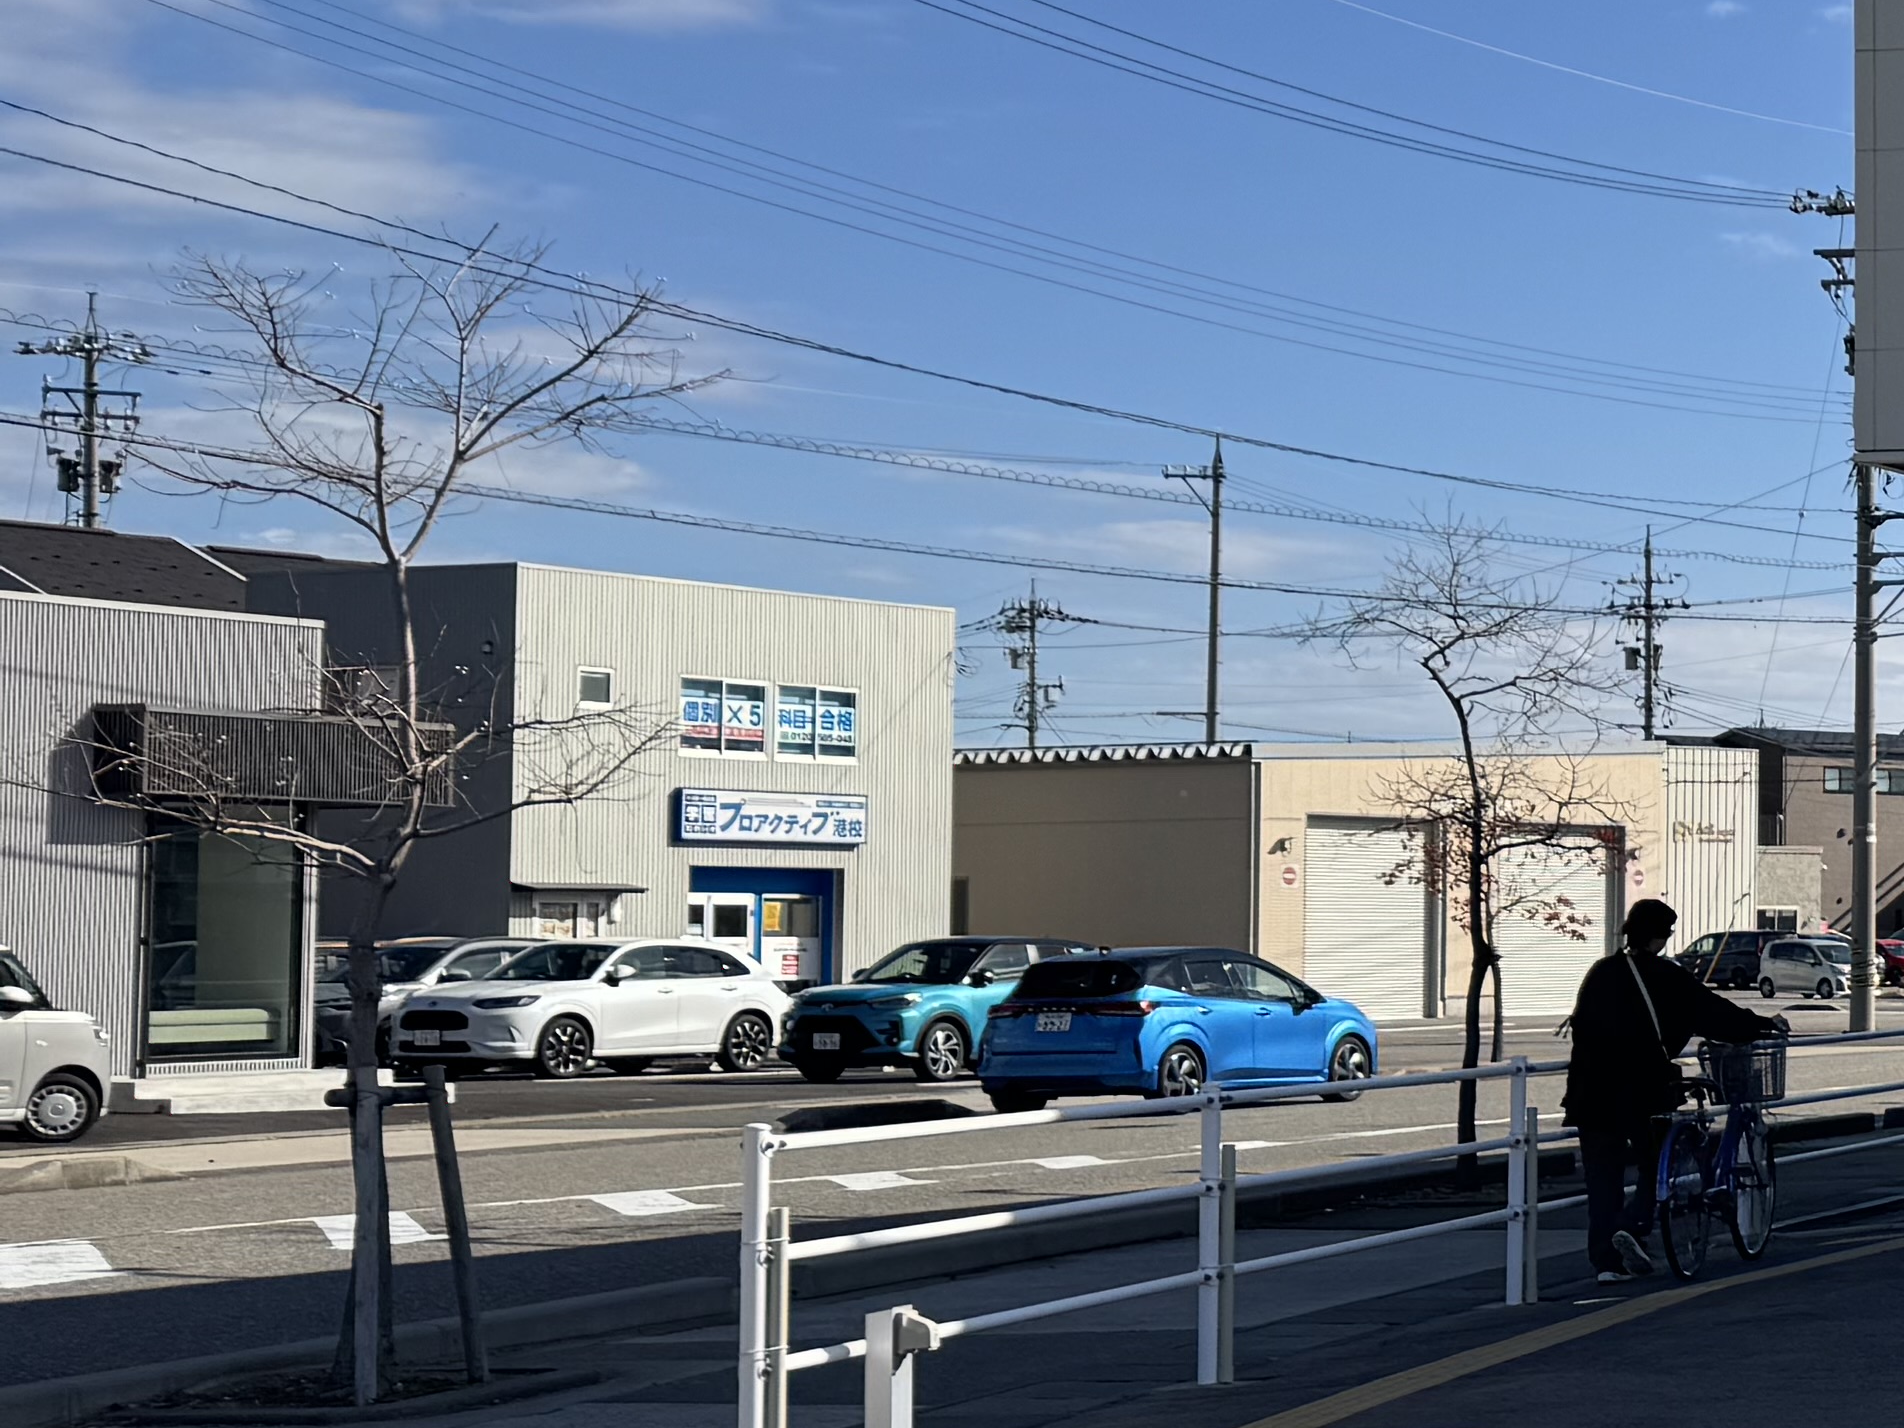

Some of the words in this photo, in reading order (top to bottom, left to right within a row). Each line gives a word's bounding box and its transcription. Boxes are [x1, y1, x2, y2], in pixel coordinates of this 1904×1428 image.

[720, 798, 840, 836] プロアクティブ
